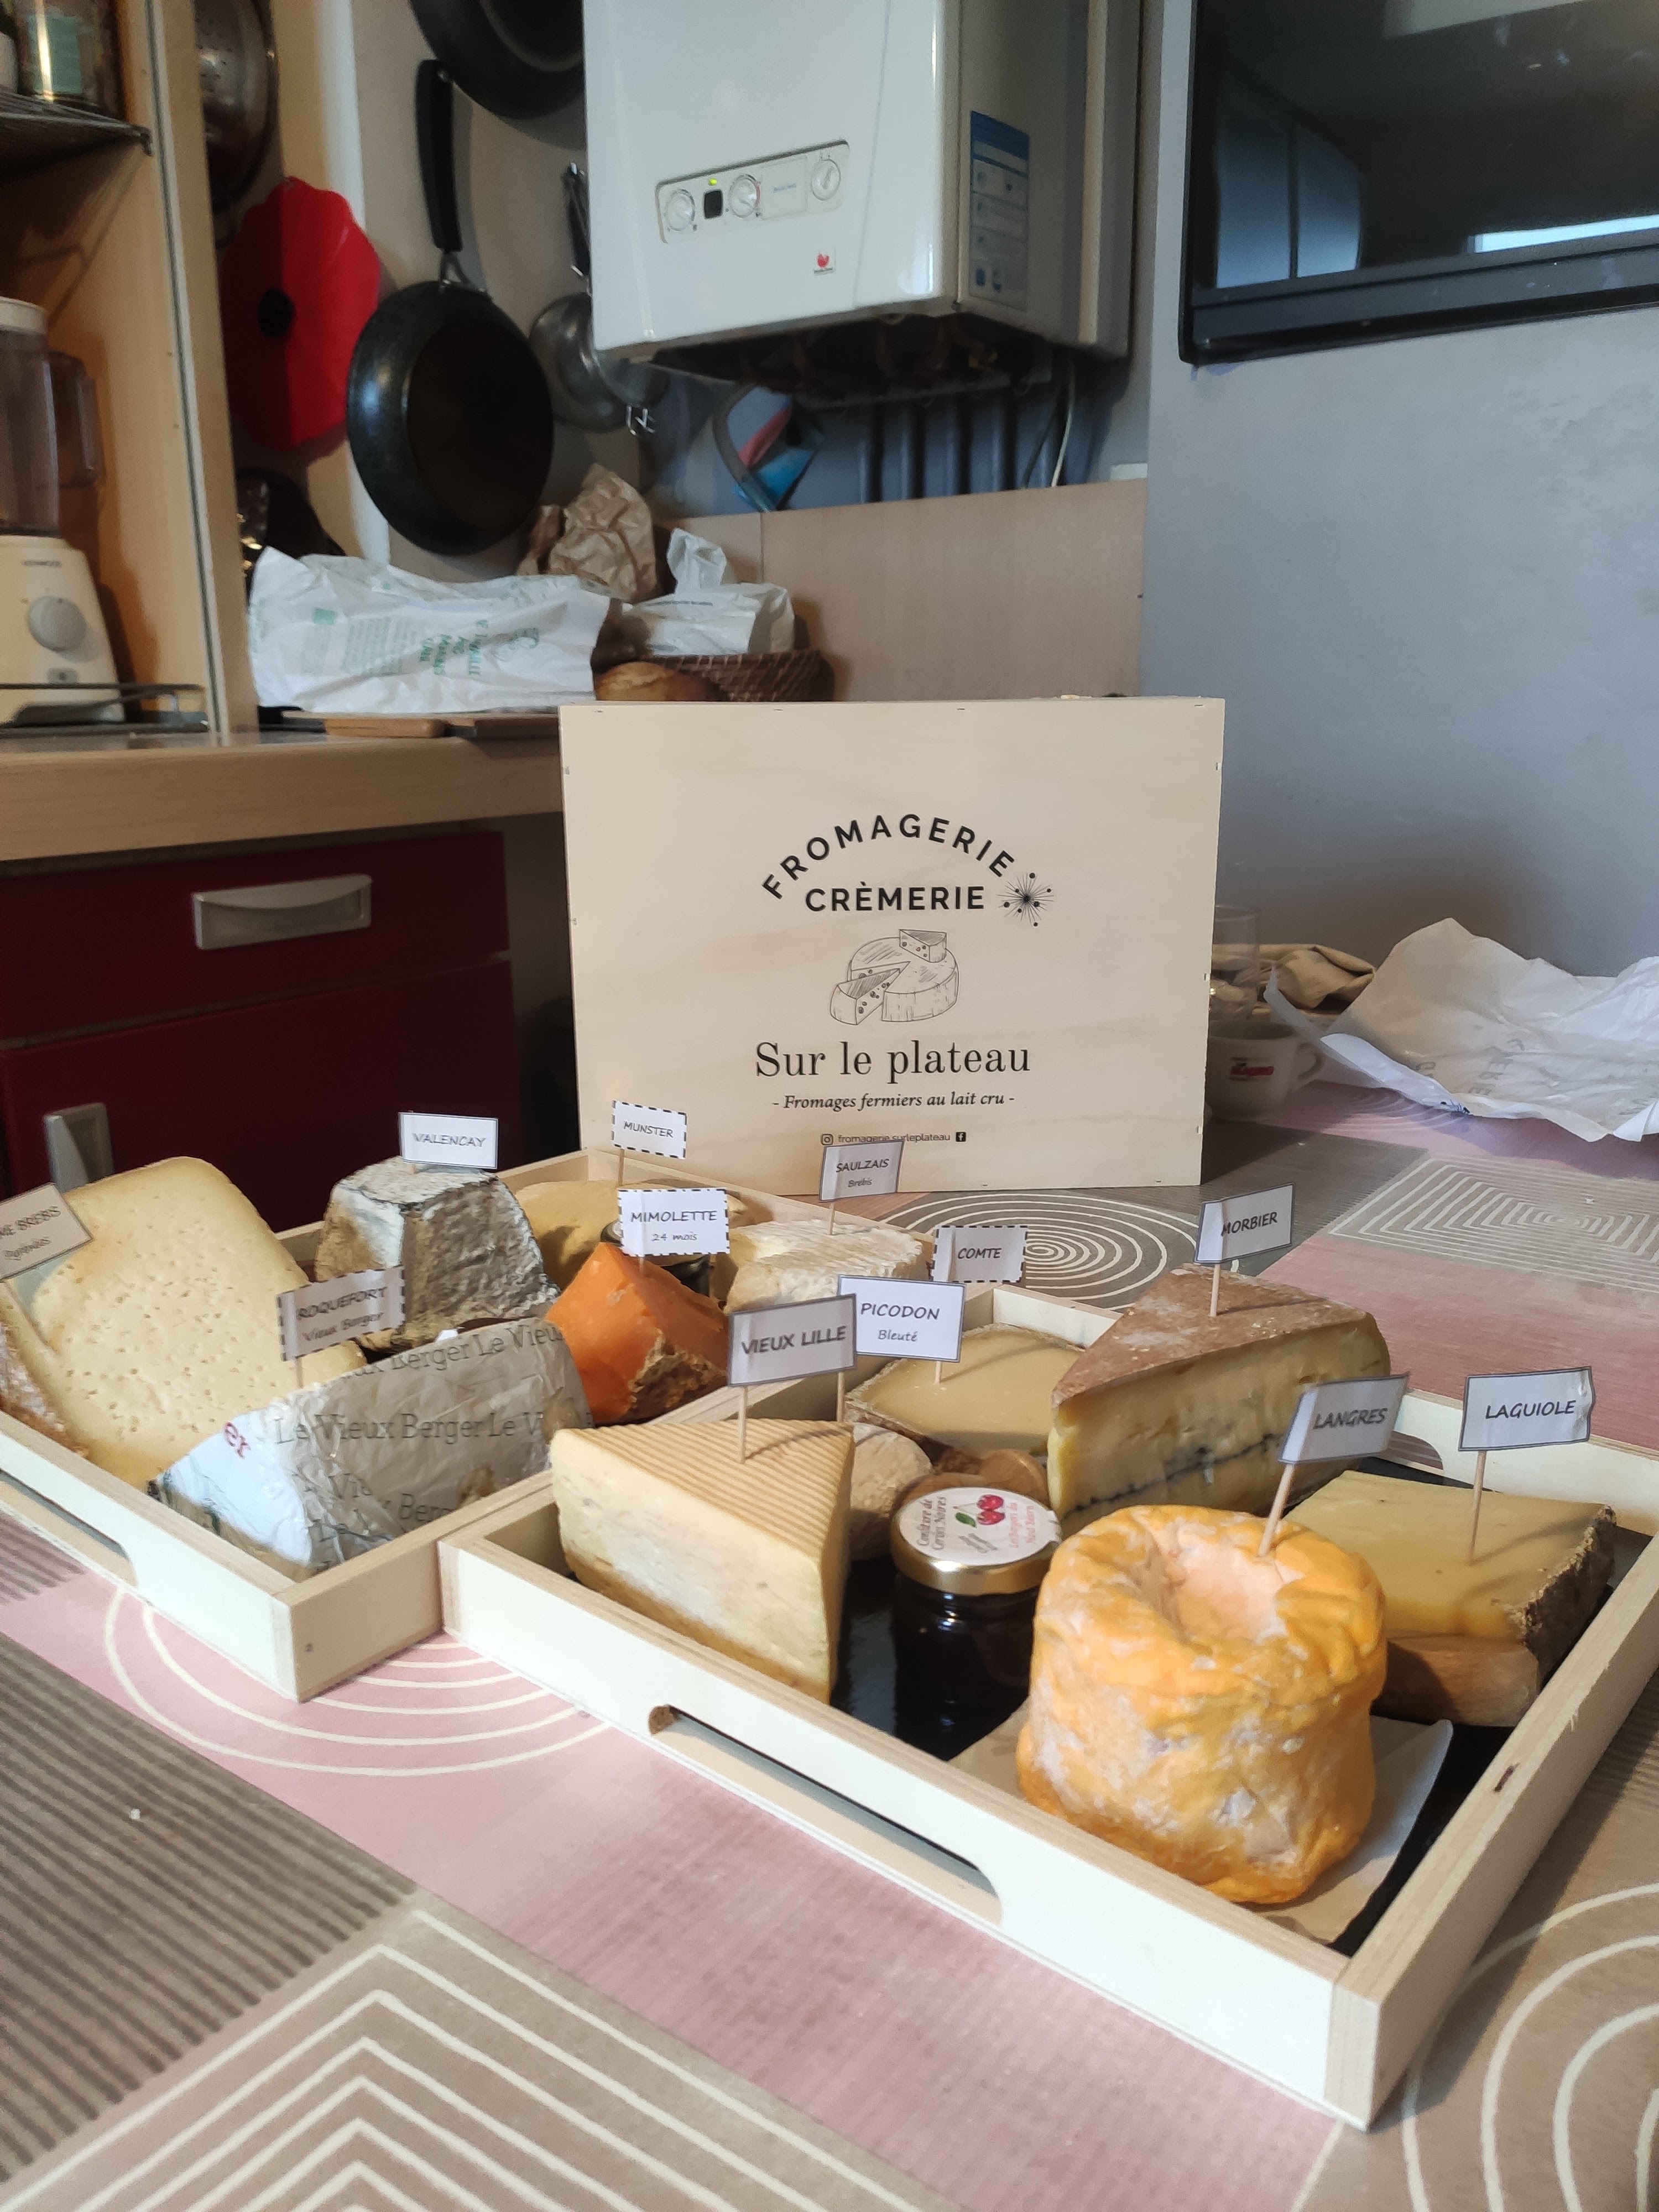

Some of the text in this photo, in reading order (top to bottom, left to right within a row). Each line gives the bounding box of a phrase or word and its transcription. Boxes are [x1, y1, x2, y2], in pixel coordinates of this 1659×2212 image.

[761, 813, 1015, 900] FROMAGERIE
[805, 880, 984, 911] CRÈMERIE
[756, 1040, 1031, 1084] Sur le plateau
[783, 1094, 857, 1112] Fromages
[858, 1092, 922, 1111] fermiers
[927, 1095, 946, 1106] au
[951, 1091, 977, 1105] lait
[980, 1094, 1005, 1104] cru
[623, 1121, 674, 1138] MUNSTER
[836, 1158, 889, 1173] SAULZAIS
[848, 1177, 873, 1188] Brebis
[630, 1210, 718, 1223] MIMOLETTE
[1220, 1212, 1278, 1238] MORBIER
[651, 1231, 697, 1241] 24 mois
[958, 1248, 1002, 1260] COMTE
[860, 1303, 940, 1321] PICODON
[472, 1333, 504, 1356] Le
[504, 1325, 563, 1348] Vieu
[742, 1326, 847, 1354] VIEUX LILLE
[878, 1329, 919, 1342] Bleuté
[1313, 1407, 1388, 1430] LANGRES
[1485, 1400, 1577, 1420] LAGUIOLE
[400, 1412, 484, 1444] Berger
[488, 1412, 515, 1437] Le
